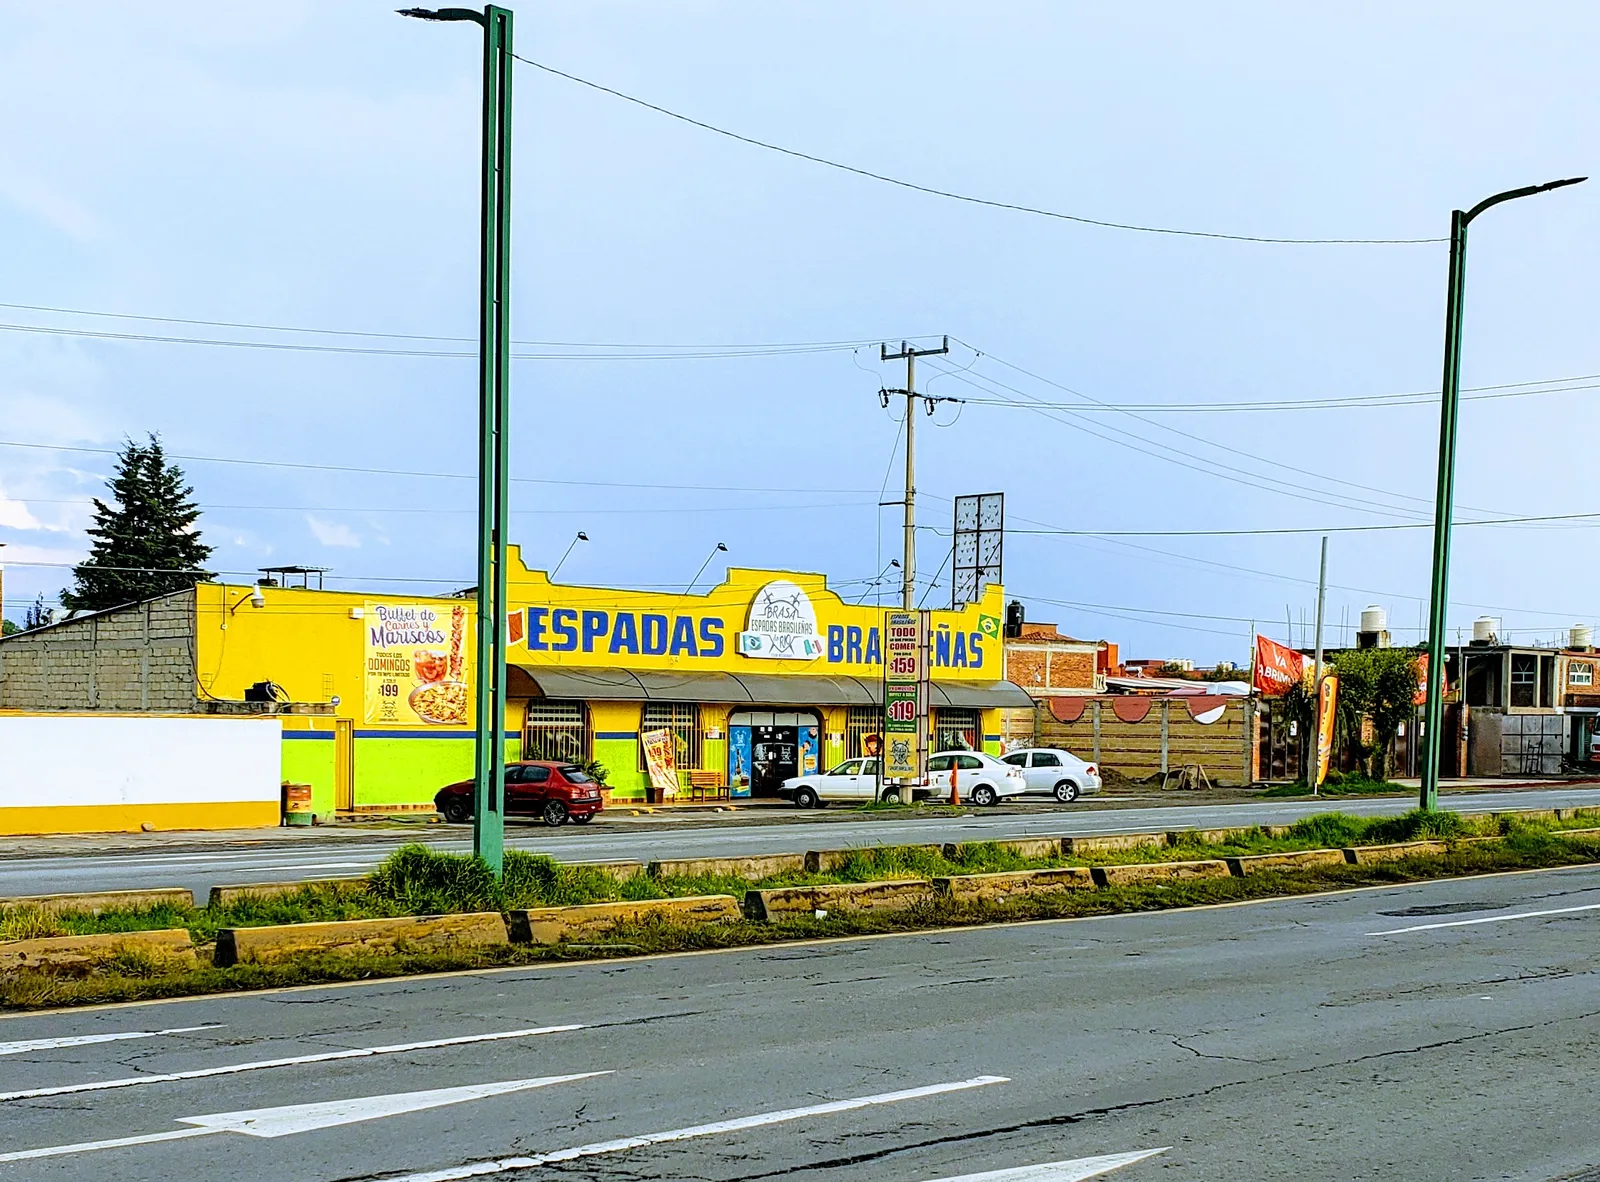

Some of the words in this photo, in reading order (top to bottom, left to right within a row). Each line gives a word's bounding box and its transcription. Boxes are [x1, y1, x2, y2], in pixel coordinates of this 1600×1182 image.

[375, 606, 416, 622] Buffet
[421, 608, 436, 621] de
[767, 605, 796, 620] BRASA
[385, 620, 420, 632] Carnes
[423, 621, 430, 631] y
[528, 607, 724, 657] ESPADAS
[751, 619, 778, 633] ESPADAS
[778, 620, 813, 635] BRASILEÑAS
[891, 627, 916, 637] TODO
[371, 626, 445, 648] Mariscos
[368, 658, 410, 671] DOMINGOS
[1273, 644, 1287, 669] YA
[889, 657, 916, 673] $159
[1258, 664, 1295, 687] ABRIMO
[377, 684, 399, 697] $199
[889, 700, 915, 721] $119
